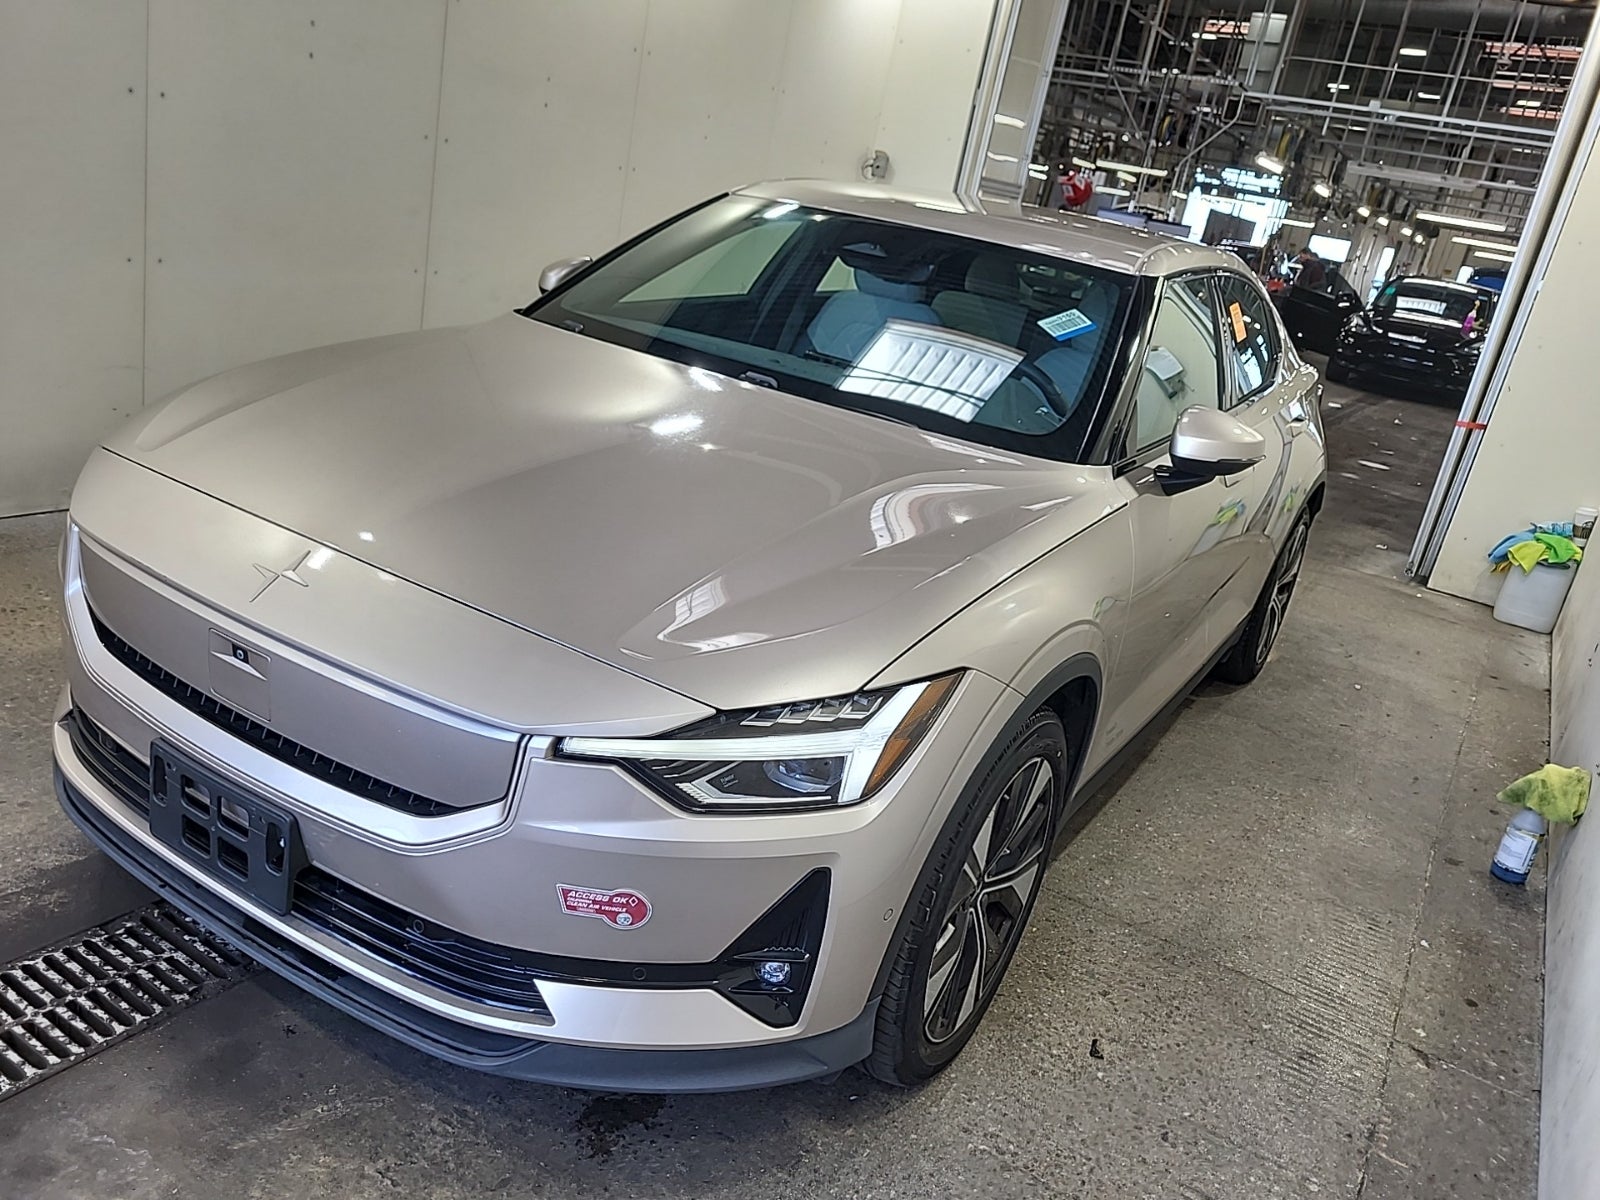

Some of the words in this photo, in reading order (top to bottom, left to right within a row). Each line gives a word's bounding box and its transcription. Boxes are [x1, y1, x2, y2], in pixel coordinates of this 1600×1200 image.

[567, 891, 610, 902] ACCESS
[612, 896, 629, 904] OK
[567, 900, 588, 908] CLEAN
